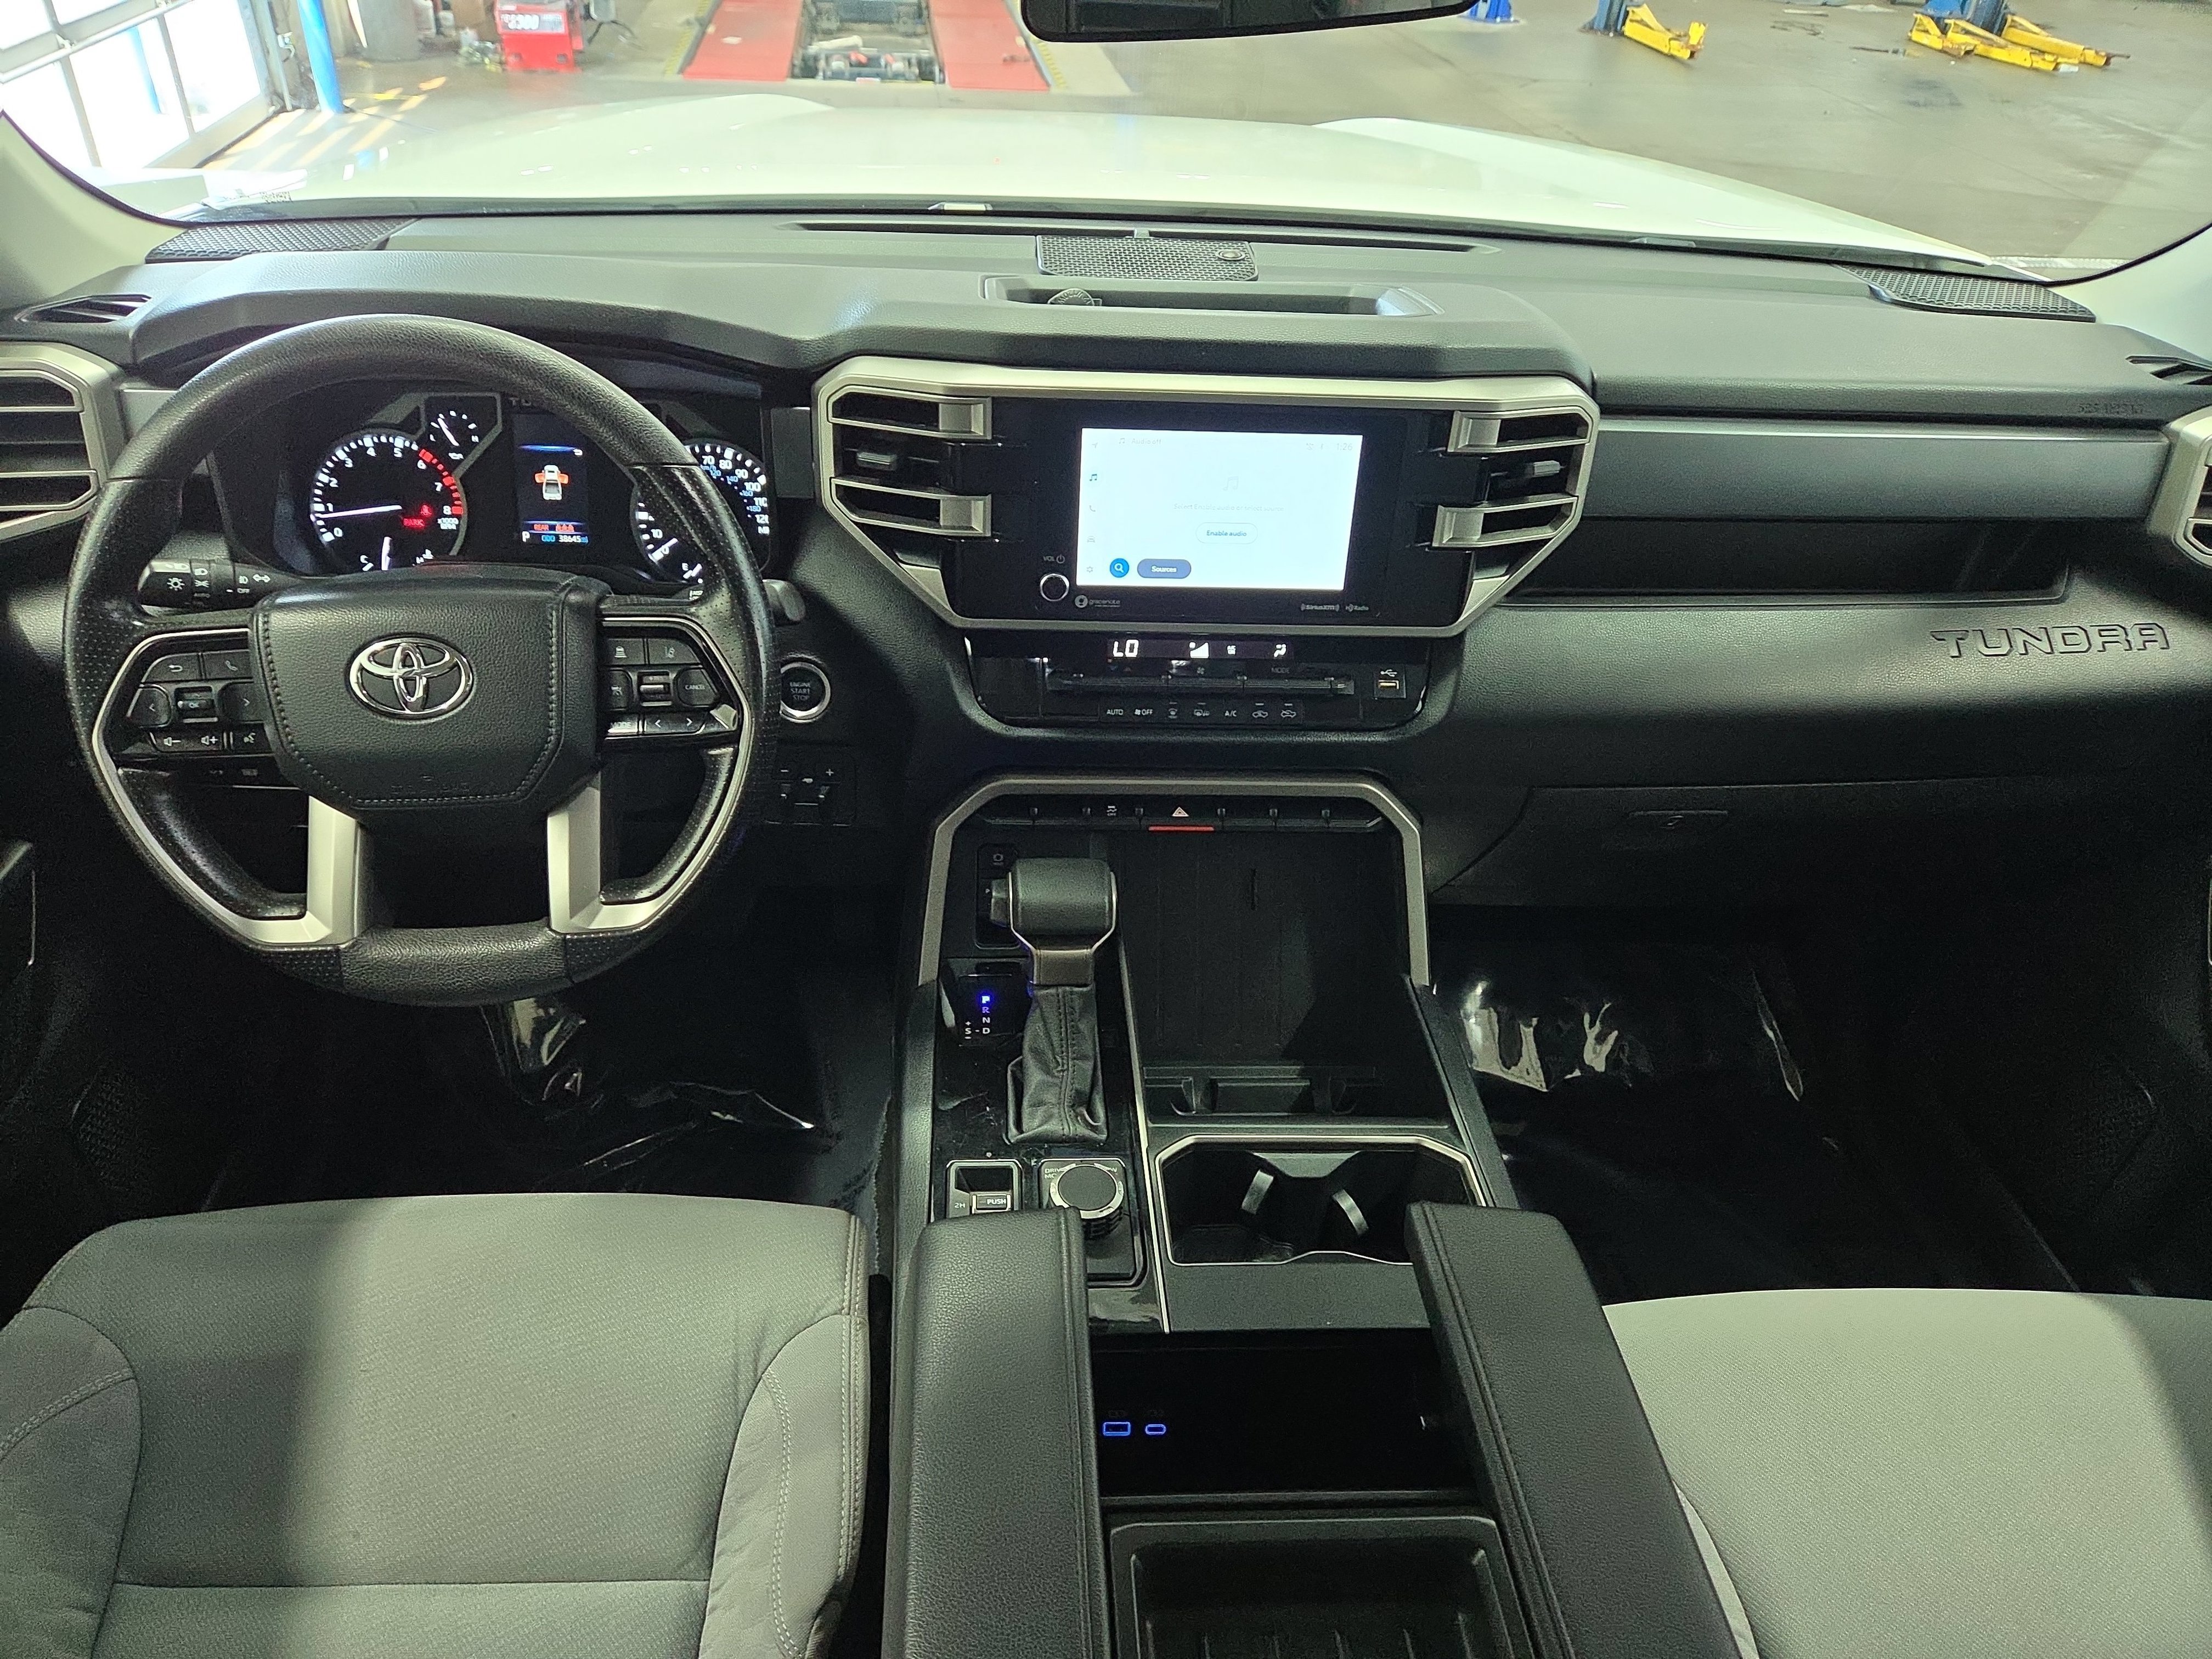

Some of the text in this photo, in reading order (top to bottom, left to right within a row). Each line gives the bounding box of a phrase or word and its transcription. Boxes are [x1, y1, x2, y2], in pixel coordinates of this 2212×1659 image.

[366, 447, 377, 457] 4
[393, 447, 403, 458] 5
[344, 458, 353, 468] 3
[417, 460, 427, 470] 6
[702, 455, 715, 465] 70
[719, 459, 733, 470] 80
[735, 469, 749, 479] 90
[329, 477, 338, 488] 2
[435, 482, 443, 492] 7
[744, 482, 762, 492] 100
[326, 503, 334, 512] 1
[443, 505, 452, 515] 8
[403, 518, 426, 527] PARK
[334, 527, 343, 537] 0
[522, 531, 531, 543] P
[651, 528, 663, 539] 10
[681, 562, 689, 571] E
[1929, 623, 2170, 658] TUNDRA
[1113, 639, 1139, 658] LO
[981, 995, 991, 1004] P
